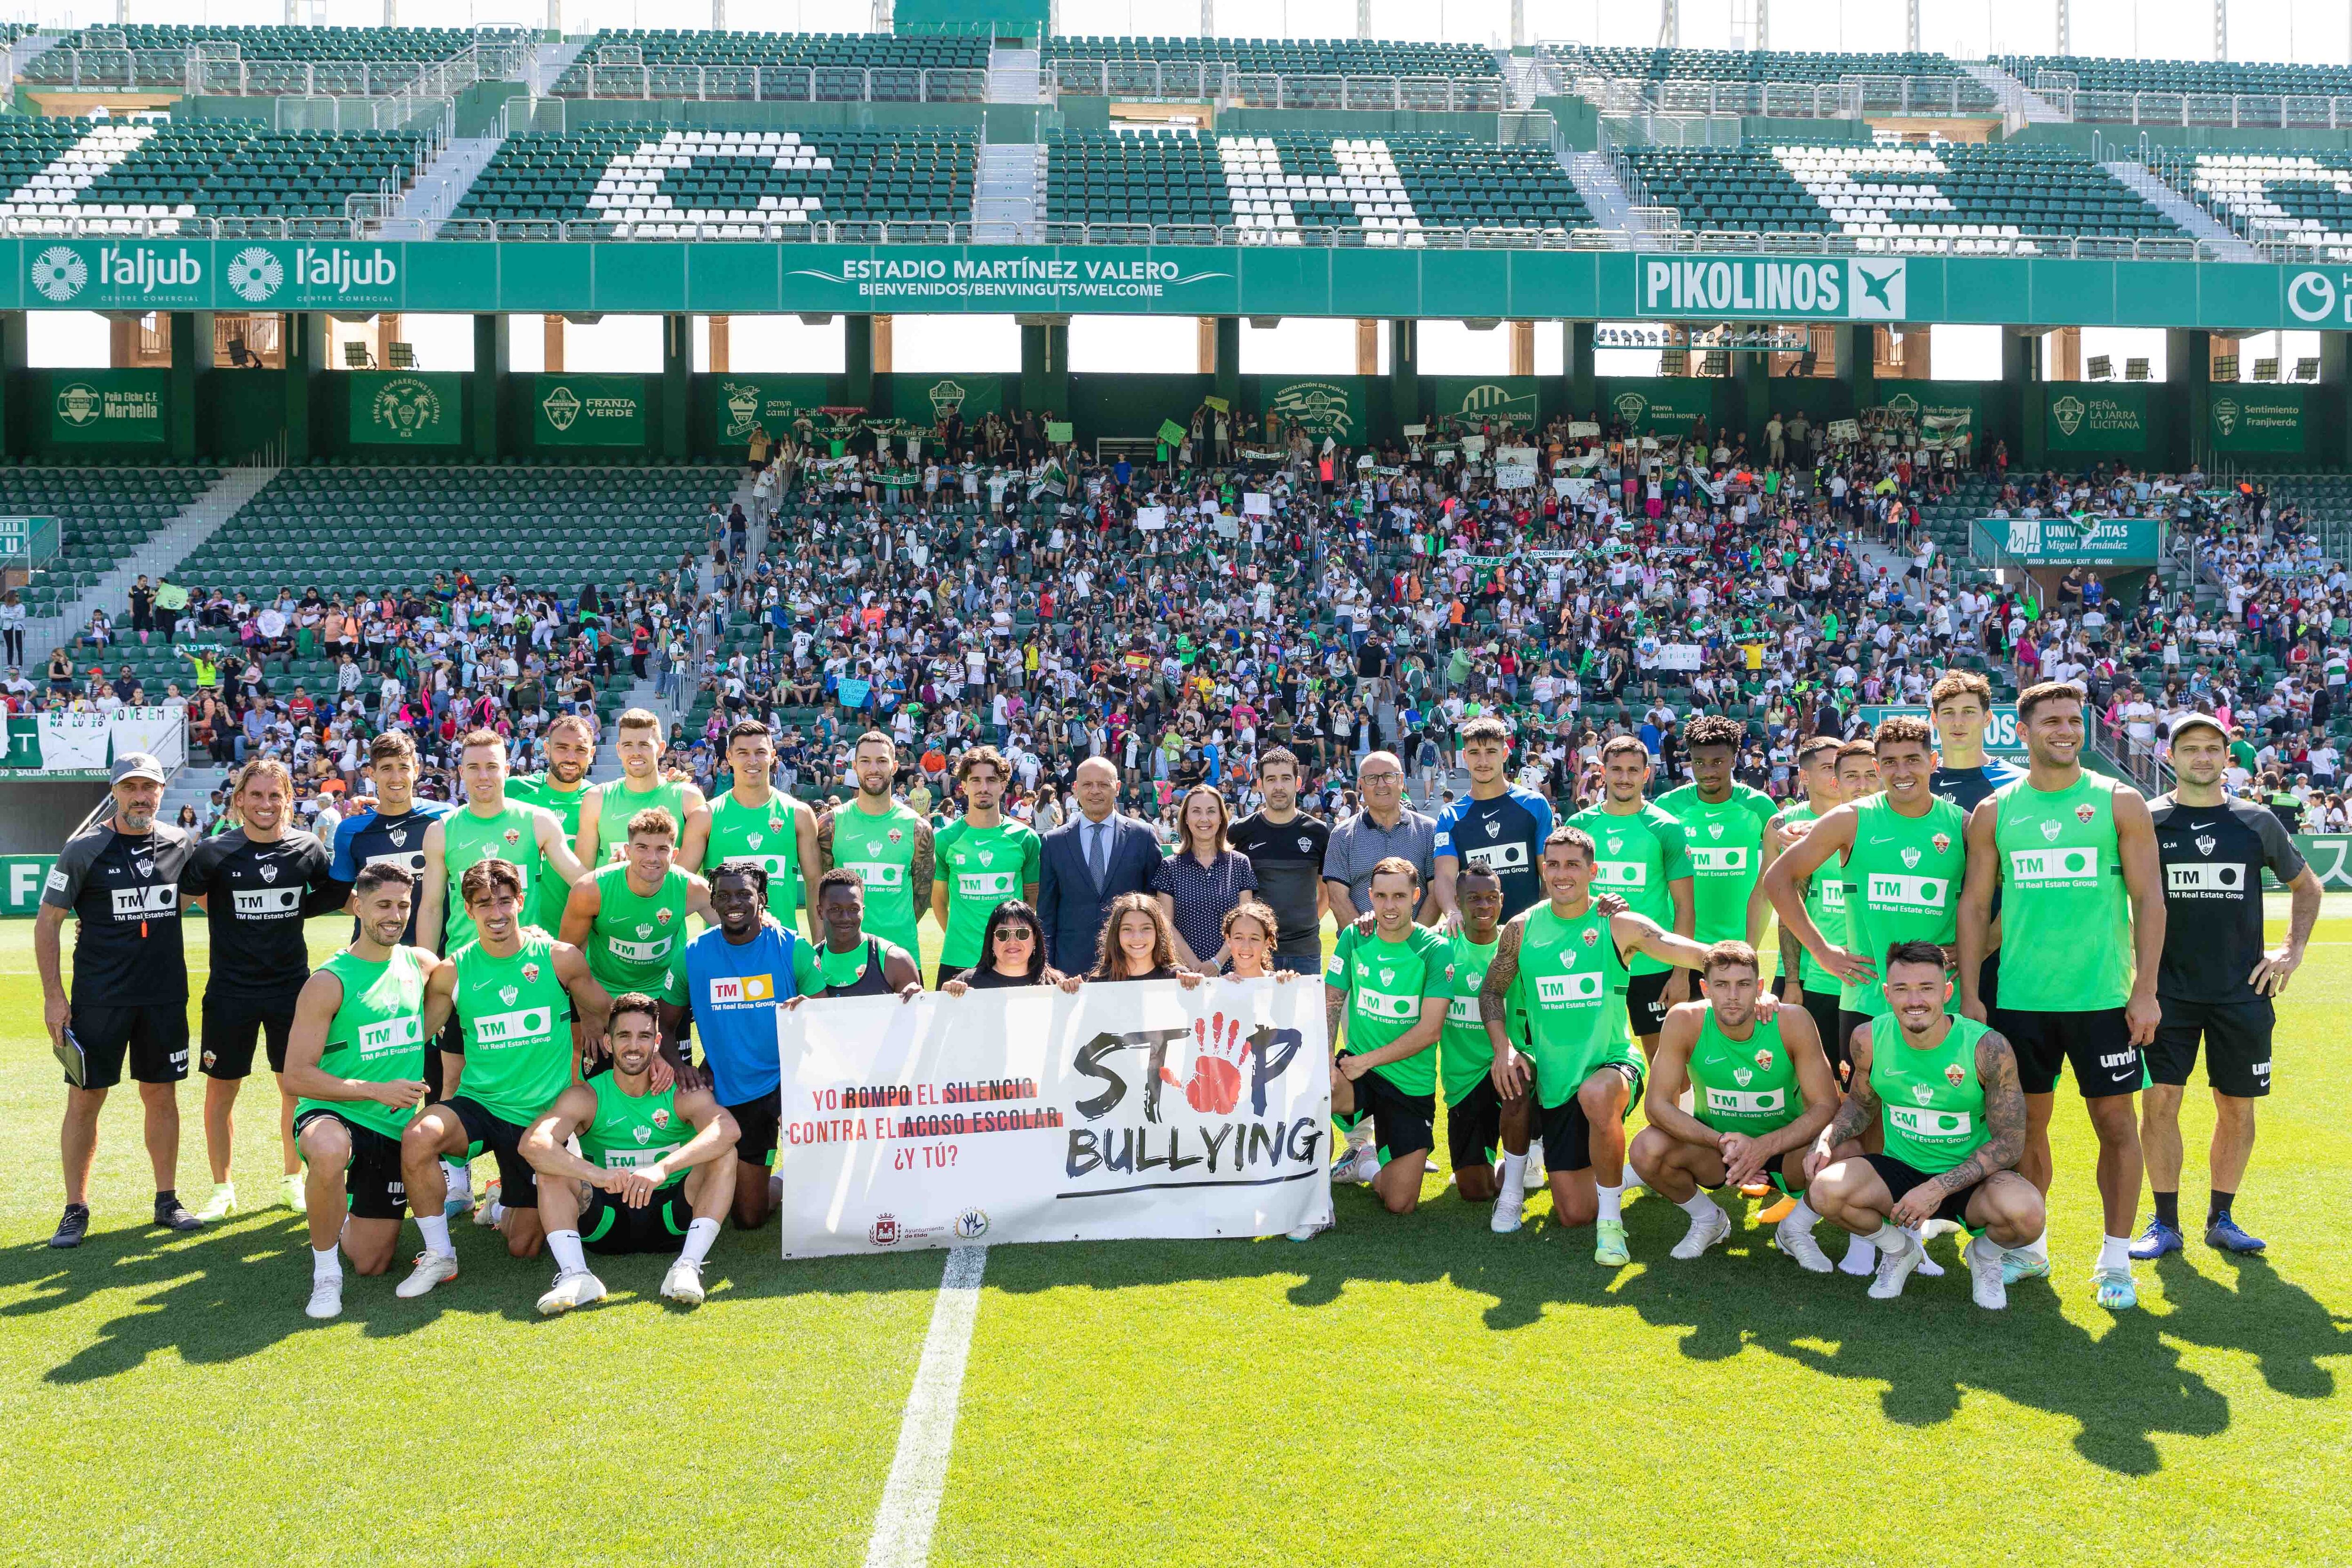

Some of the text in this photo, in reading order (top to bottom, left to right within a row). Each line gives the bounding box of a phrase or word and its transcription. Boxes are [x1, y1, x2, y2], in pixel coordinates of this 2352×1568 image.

[843, 256, 1179, 280] ESTADIO MARTÍNEZ VALERO
[859, 282, 1163, 297] BIENVENIDOS/BENVINGUTS/WELCOME
[1647, 262, 1840, 311] PIKOLINOS
[1277, 382, 1317, 396] FEDERACIÓN
[1327, 383, 1348, 396] PEÑAS
[104, 392, 121, 402] Peña
[124, 392, 143, 401] Elche
[586, 399, 636, 407] FRANJA
[104, 402, 157, 418] Marbella
[2090, 399, 2117, 410] PEÑA
[2244, 405, 2299, 414] Sentimiento
[586, 409, 634, 417] VERDE
[2104, 411, 2136, 420] JARRA
[2090, 420, 2140, 429] ILICITANA
[2246, 418, 2297, 428] Franjiverde
[1593, 547, 1615, 555] ELCHE
[2046, 540, 2128, 553] Miguel ernández
[1684, 826, 1697, 836] 26
[955, 854, 966, 865] 15
[1691, 853, 1710, 865] TM
[2016, 858, 2043, 874] TM
[2072, 879, 2098, 887] Group
[2173, 871, 2200, 884] TM
[961, 879, 981, 890] TM
[1874, 881, 1901, 897] TM
[118, 895, 143, 908] TM
[238, 896, 262, 908] TM
[1900, 905, 1922, 914] Estate
[613, 940, 635, 955] TM
[715, 984, 737, 997] TM
[1541, 983, 1564, 996] TM
[1362, 993, 1380, 1009] TM
[479, 1021, 506, 1037] TM
[365, 1027, 390, 1045] TM
[507, 1039, 529, 1048] Estate
[531, 1035, 551, 1044] Group
[2100, 1045, 2136, 1067] umh
[813, 1077, 1033, 1111] YO ROMPO EL SILENCIO
[1711, 1094, 1737, 1107] TM
[789, 1107, 1058, 1145] CONTRA EL ACOSO ESCOLAR
[1901, 1130, 1971, 1144] Real Estate Group
[1066, 1117, 1324, 1179] BULLYING
[610, 1156, 636, 1167] TM
[894, 1142, 958, 1170] ¿Y TÚ?
[905, 1226, 945, 1234] Ayuntamiento
